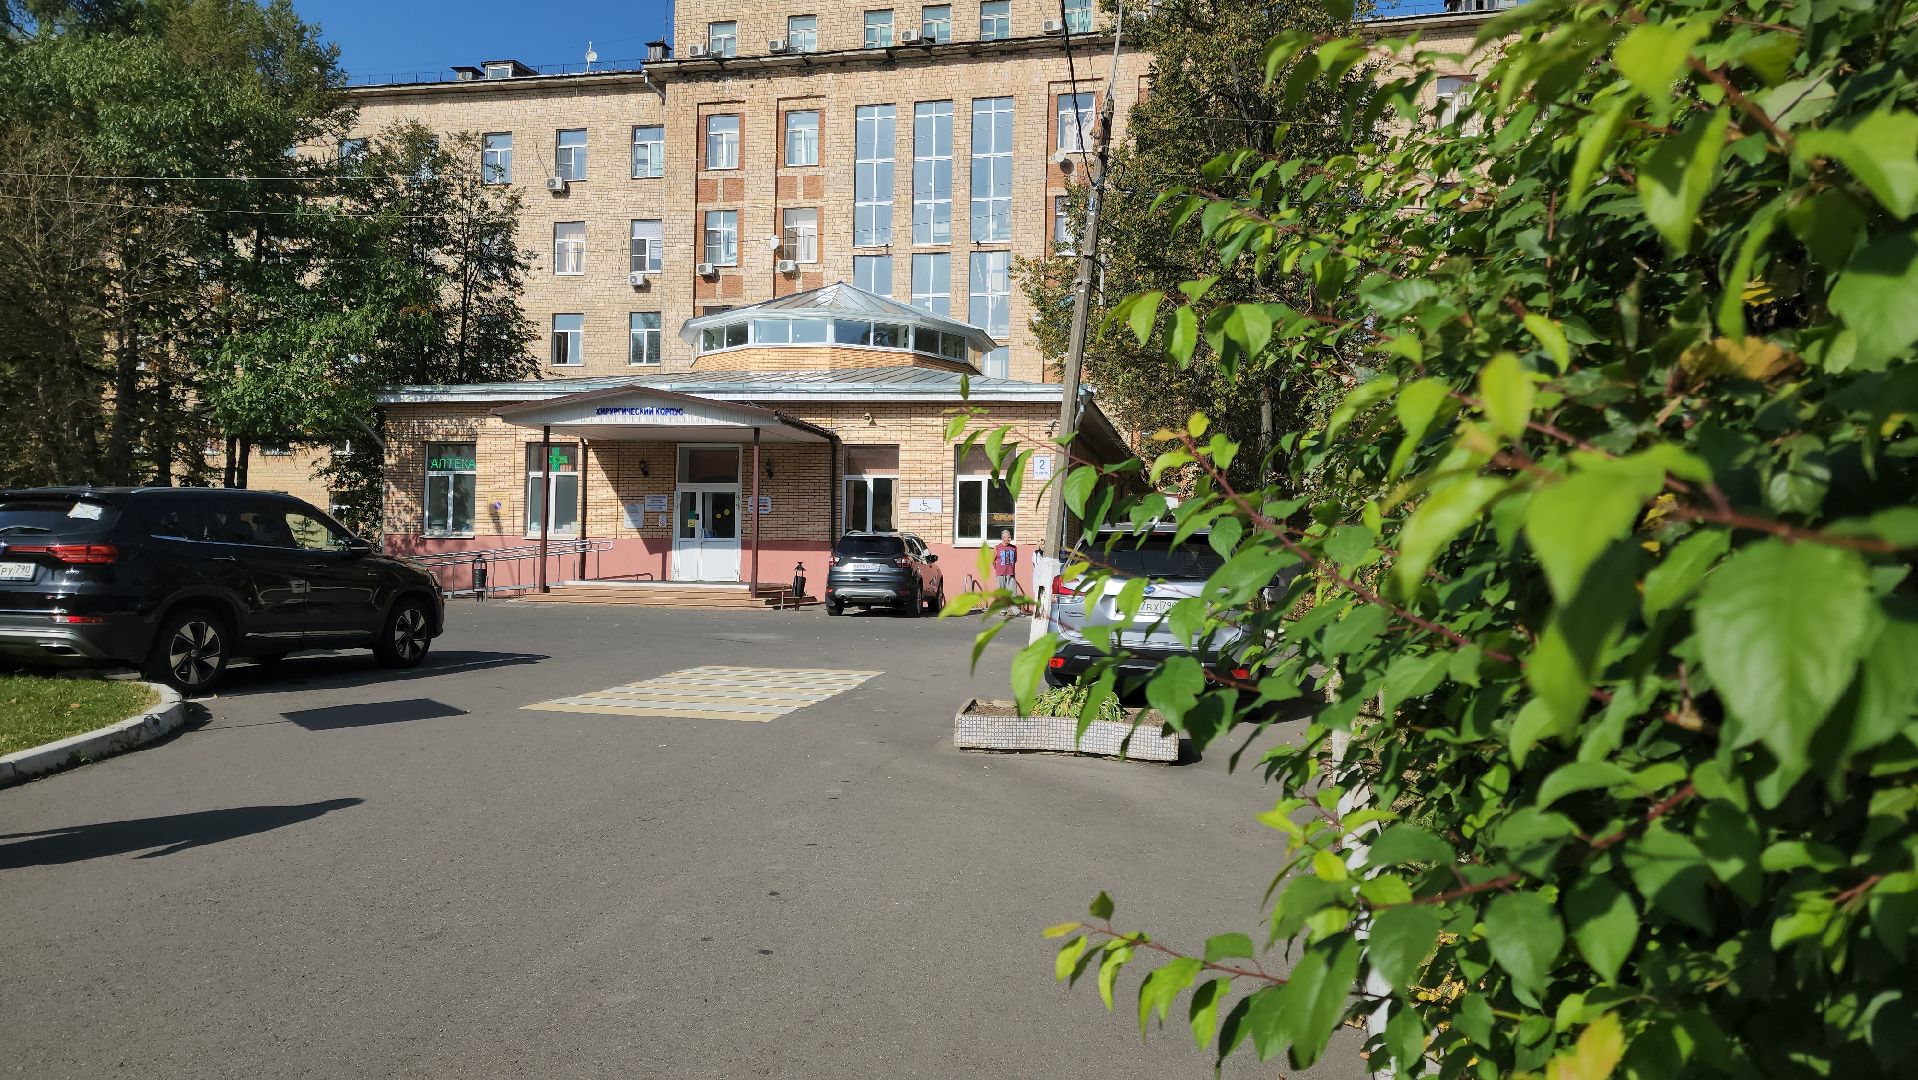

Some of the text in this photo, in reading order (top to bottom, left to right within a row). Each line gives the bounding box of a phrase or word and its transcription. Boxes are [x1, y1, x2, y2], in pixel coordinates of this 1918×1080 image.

[596, 406, 684, 416] ХИРУРГИЧЕСКИЙ КОРПУС
[430, 458, 477, 470] АПТЕКА
[1039, 459, 1045, 470] 2
[15, 564, 31, 574] 790
